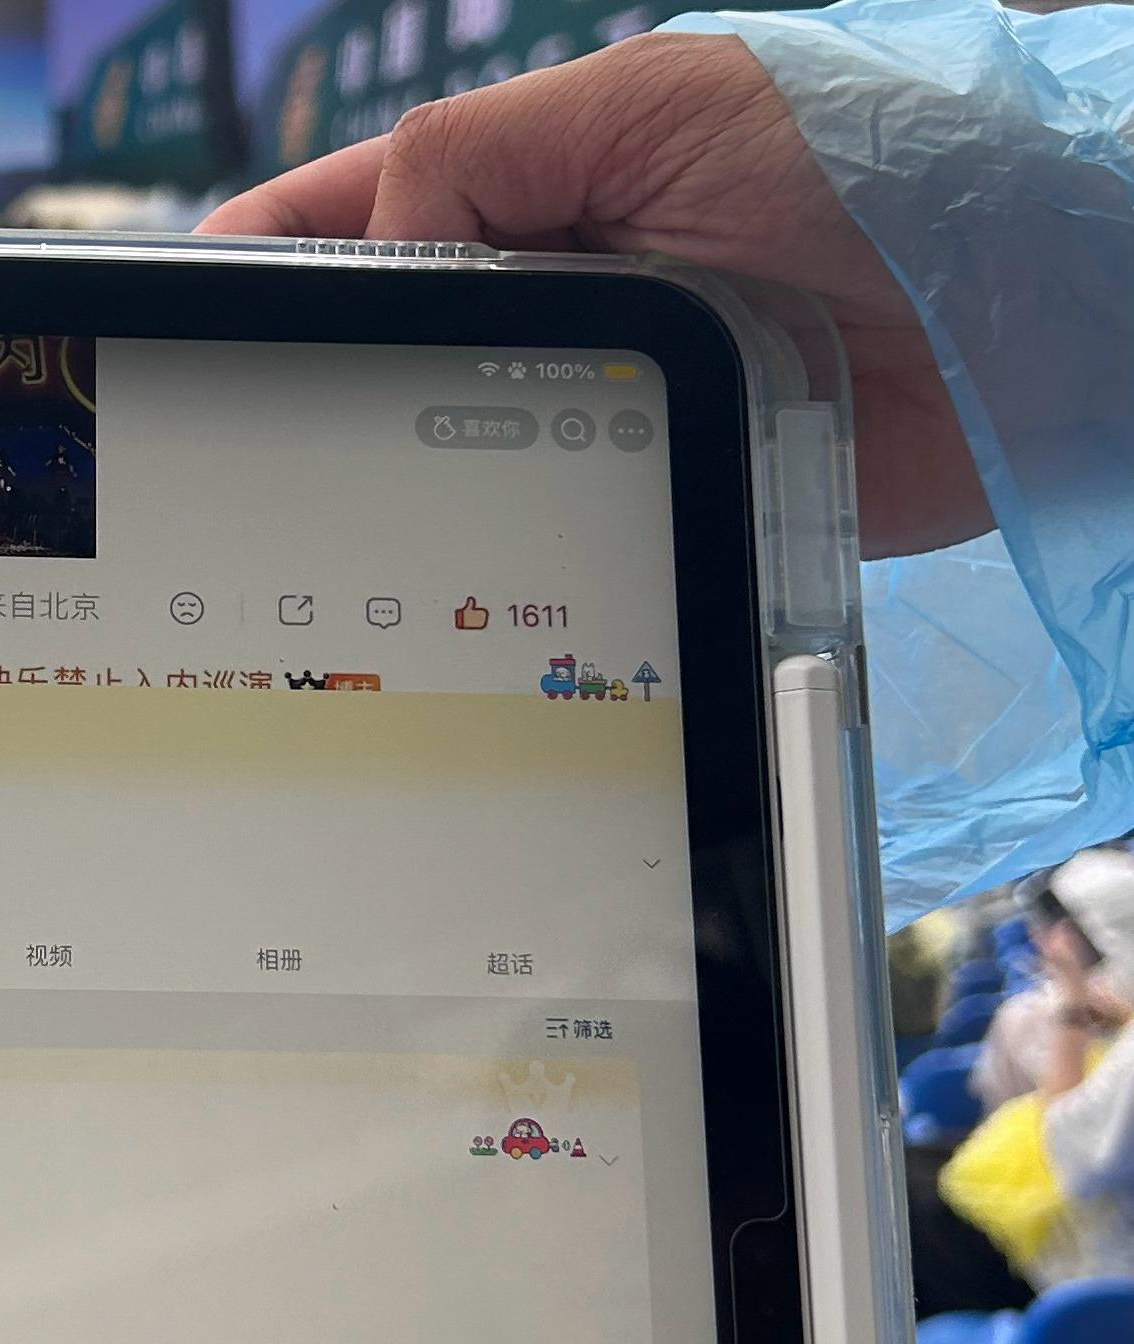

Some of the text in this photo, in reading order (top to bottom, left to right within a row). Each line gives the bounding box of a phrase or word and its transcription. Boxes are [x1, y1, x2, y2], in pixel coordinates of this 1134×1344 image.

[535, 363, 595, 380] 100%
[461, 419, 520, 439] 喜欢你
[507, 604, 568, 628] 1611
[25, 944, 73, 967] 视频
[256, 948, 302, 972] 相册
[487, 953, 534, 976] 超话
[571, 1017, 615, 1041] 筛选
